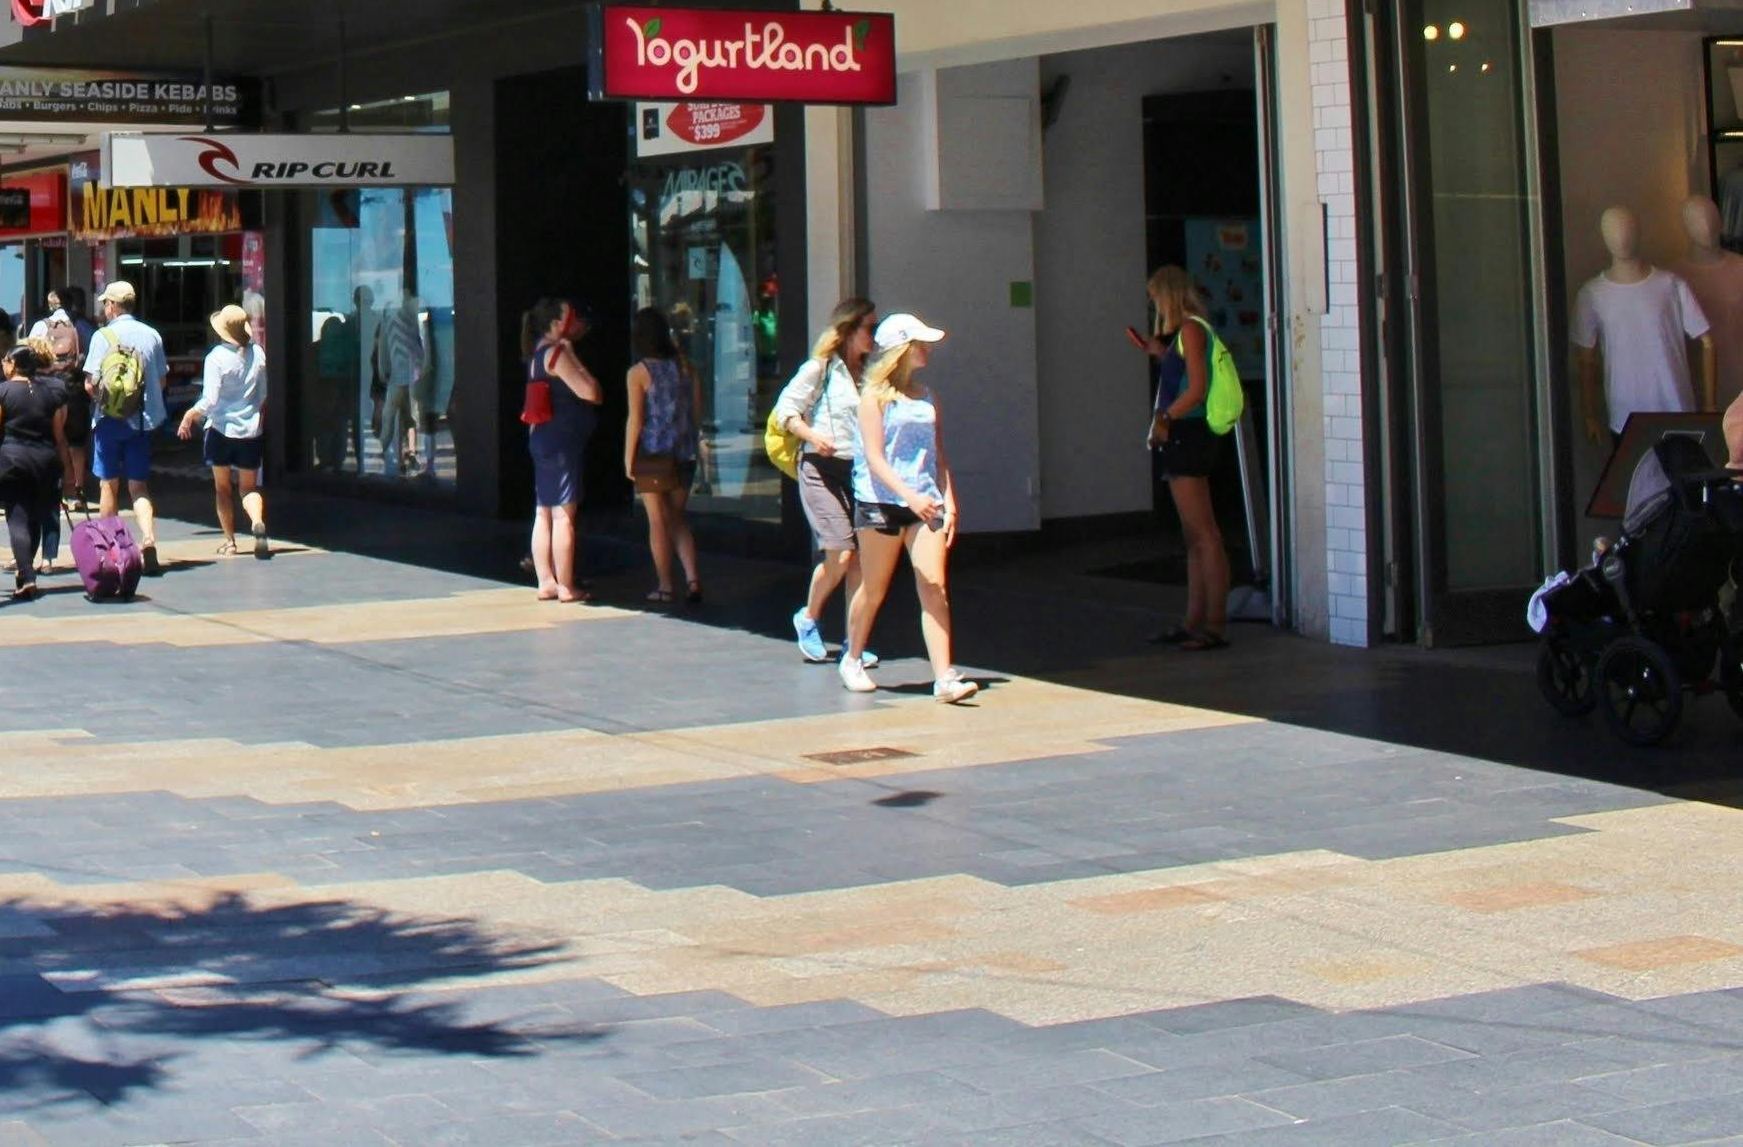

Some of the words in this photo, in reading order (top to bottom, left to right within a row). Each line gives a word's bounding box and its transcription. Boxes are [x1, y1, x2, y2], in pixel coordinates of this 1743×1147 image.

[626, 17, 862, 94] Yogurtland
[59, 80, 149, 100] SEASIDE
[155, 82, 238, 102] KEBABS
[33, 100, 77, 113] Burgers
[87, 101, 119, 113] Chips
[129, 103, 158, 114] Pizza
[168, 103, 193, 114] Pide
[692, 105, 742, 125] PACKAGES
[251, 161, 308, 179] RIP
[310, 161, 396, 179] CURL
[82, 181, 190, 229] MANLY
